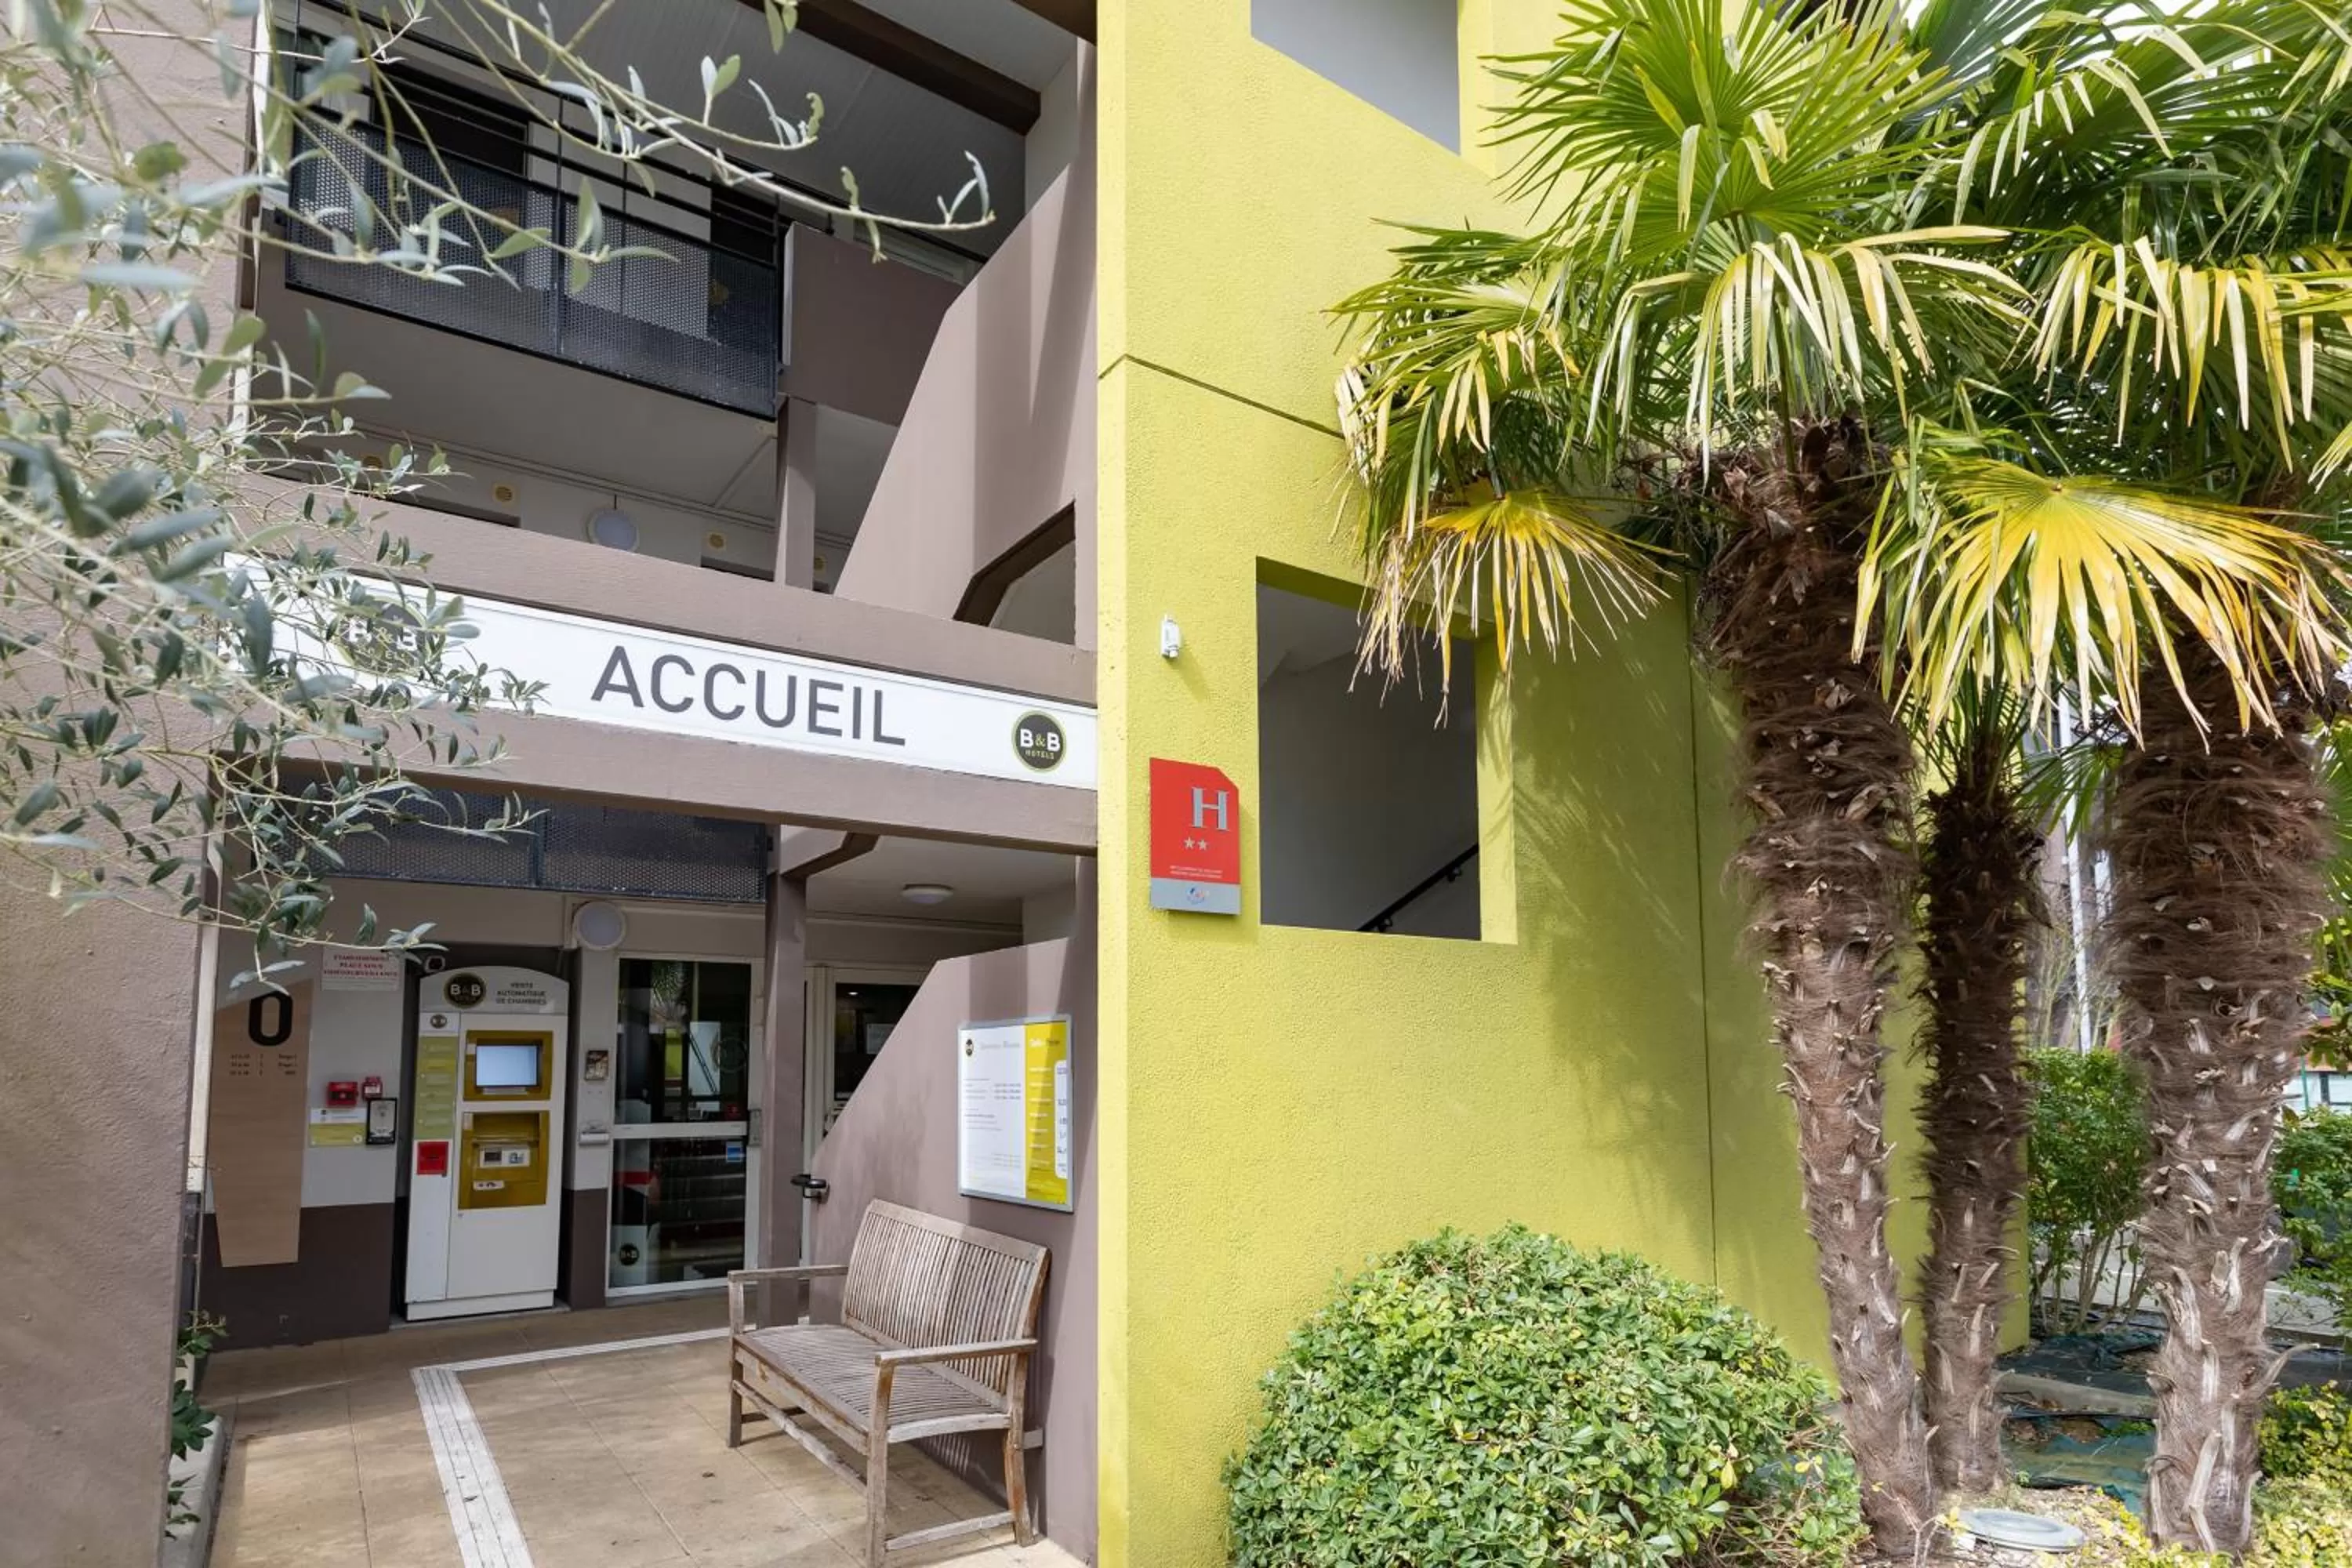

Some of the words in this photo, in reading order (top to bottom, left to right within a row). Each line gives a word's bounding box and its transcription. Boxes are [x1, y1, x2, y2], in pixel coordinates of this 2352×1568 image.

[590, 645, 906, 747] ACCUEIL
[1020, 728, 1061, 752] B&B
[1025, 749, 1054, 760] HOTELS
[1191, 786, 1231, 831] H
